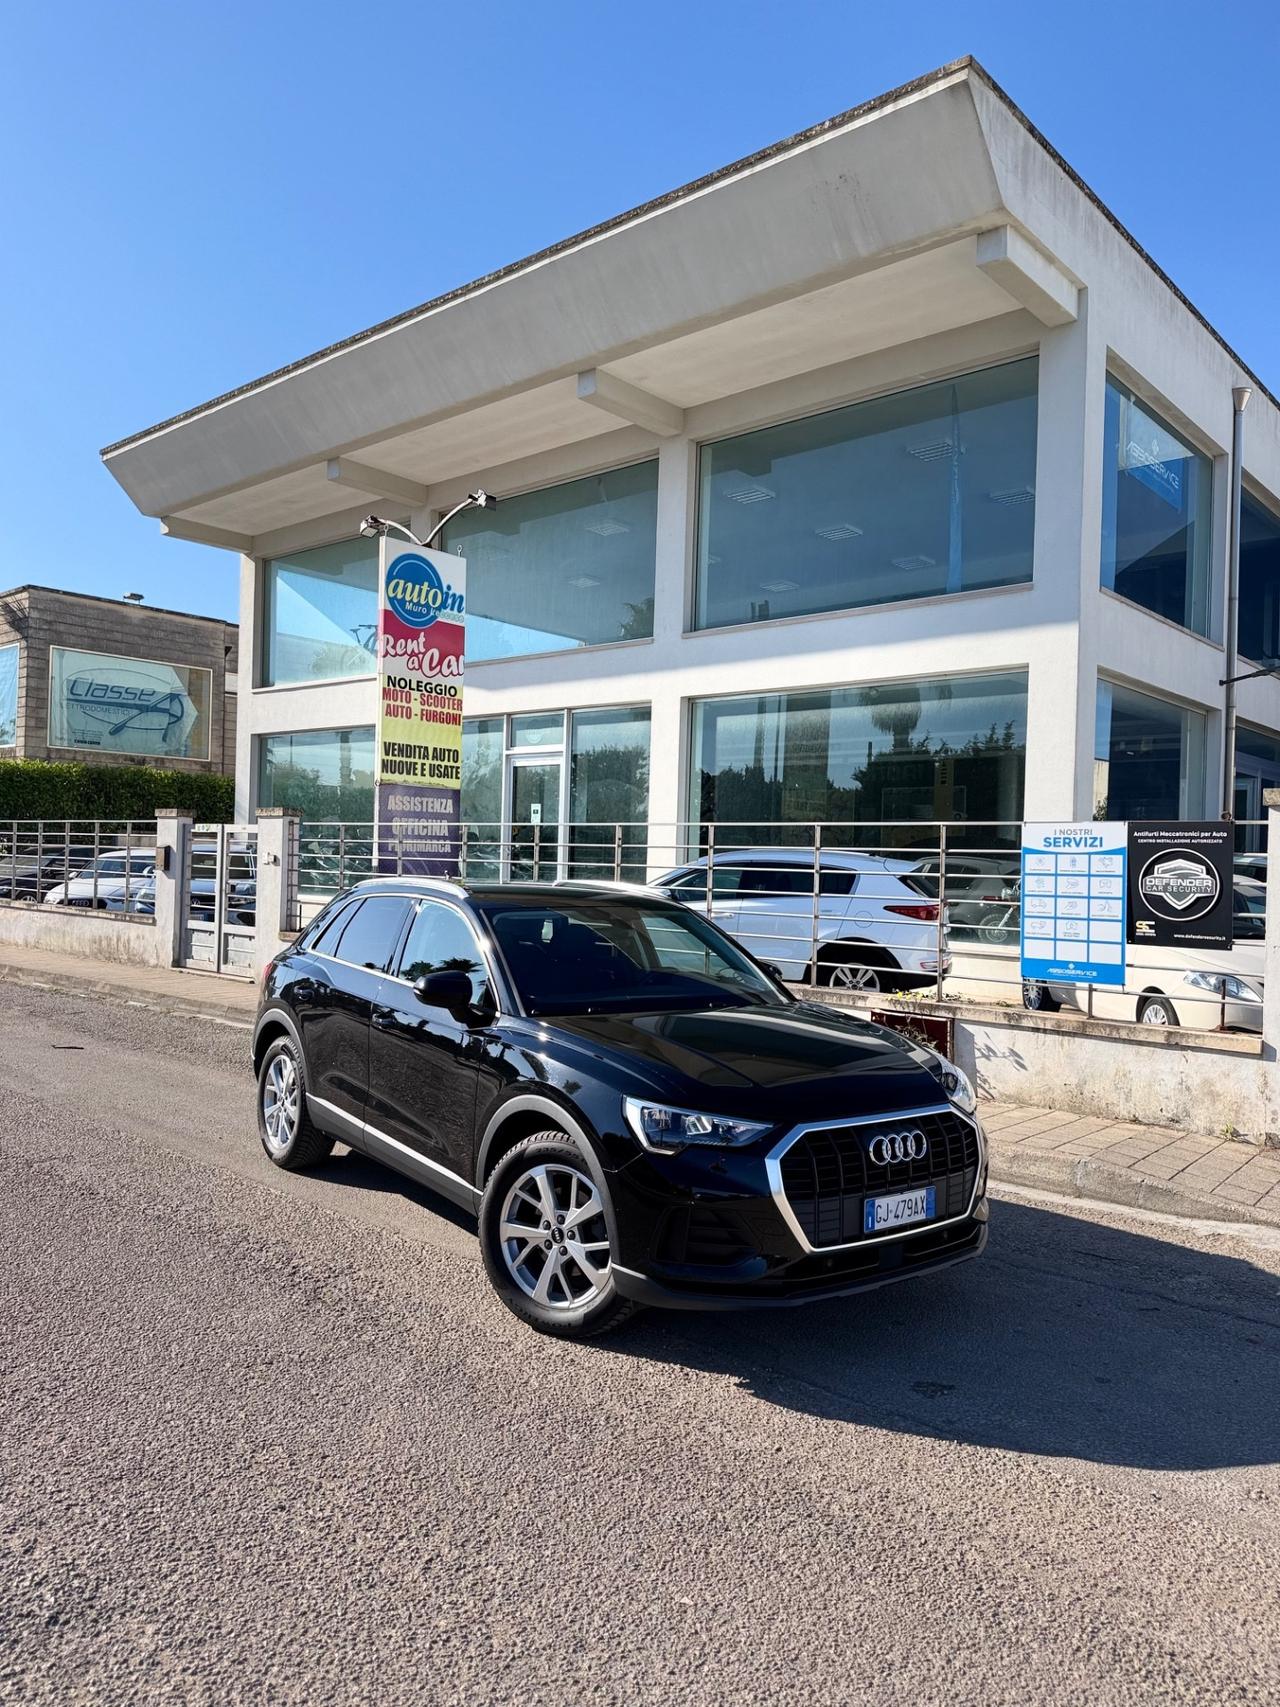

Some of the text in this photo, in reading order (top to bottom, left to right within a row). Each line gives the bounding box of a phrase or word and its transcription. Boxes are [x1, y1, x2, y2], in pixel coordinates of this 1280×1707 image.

[405, 601, 427, 614] Muro
[382, 631, 426, 657] Rent
[70, 677, 156, 703] Classe
[386, 674, 458, 698] NOLEGGIO
[382, 686, 412, 705] MOTO
[419, 692, 463, 712] SCOOTER
[385, 702, 412, 720] AUTO
[420, 712, 461, 727] FURGONI
[383, 741, 460, 763] VENDITA AUTO
[381, 758, 460, 780] NUOVE E USATE
[387, 795, 454, 814] ASSISTENZA
[391, 816, 449, 837] OFFICINA
[1043, 837, 1103, 848] SERVIZI
[1146, 878, 1212, 886] DEFENDER
